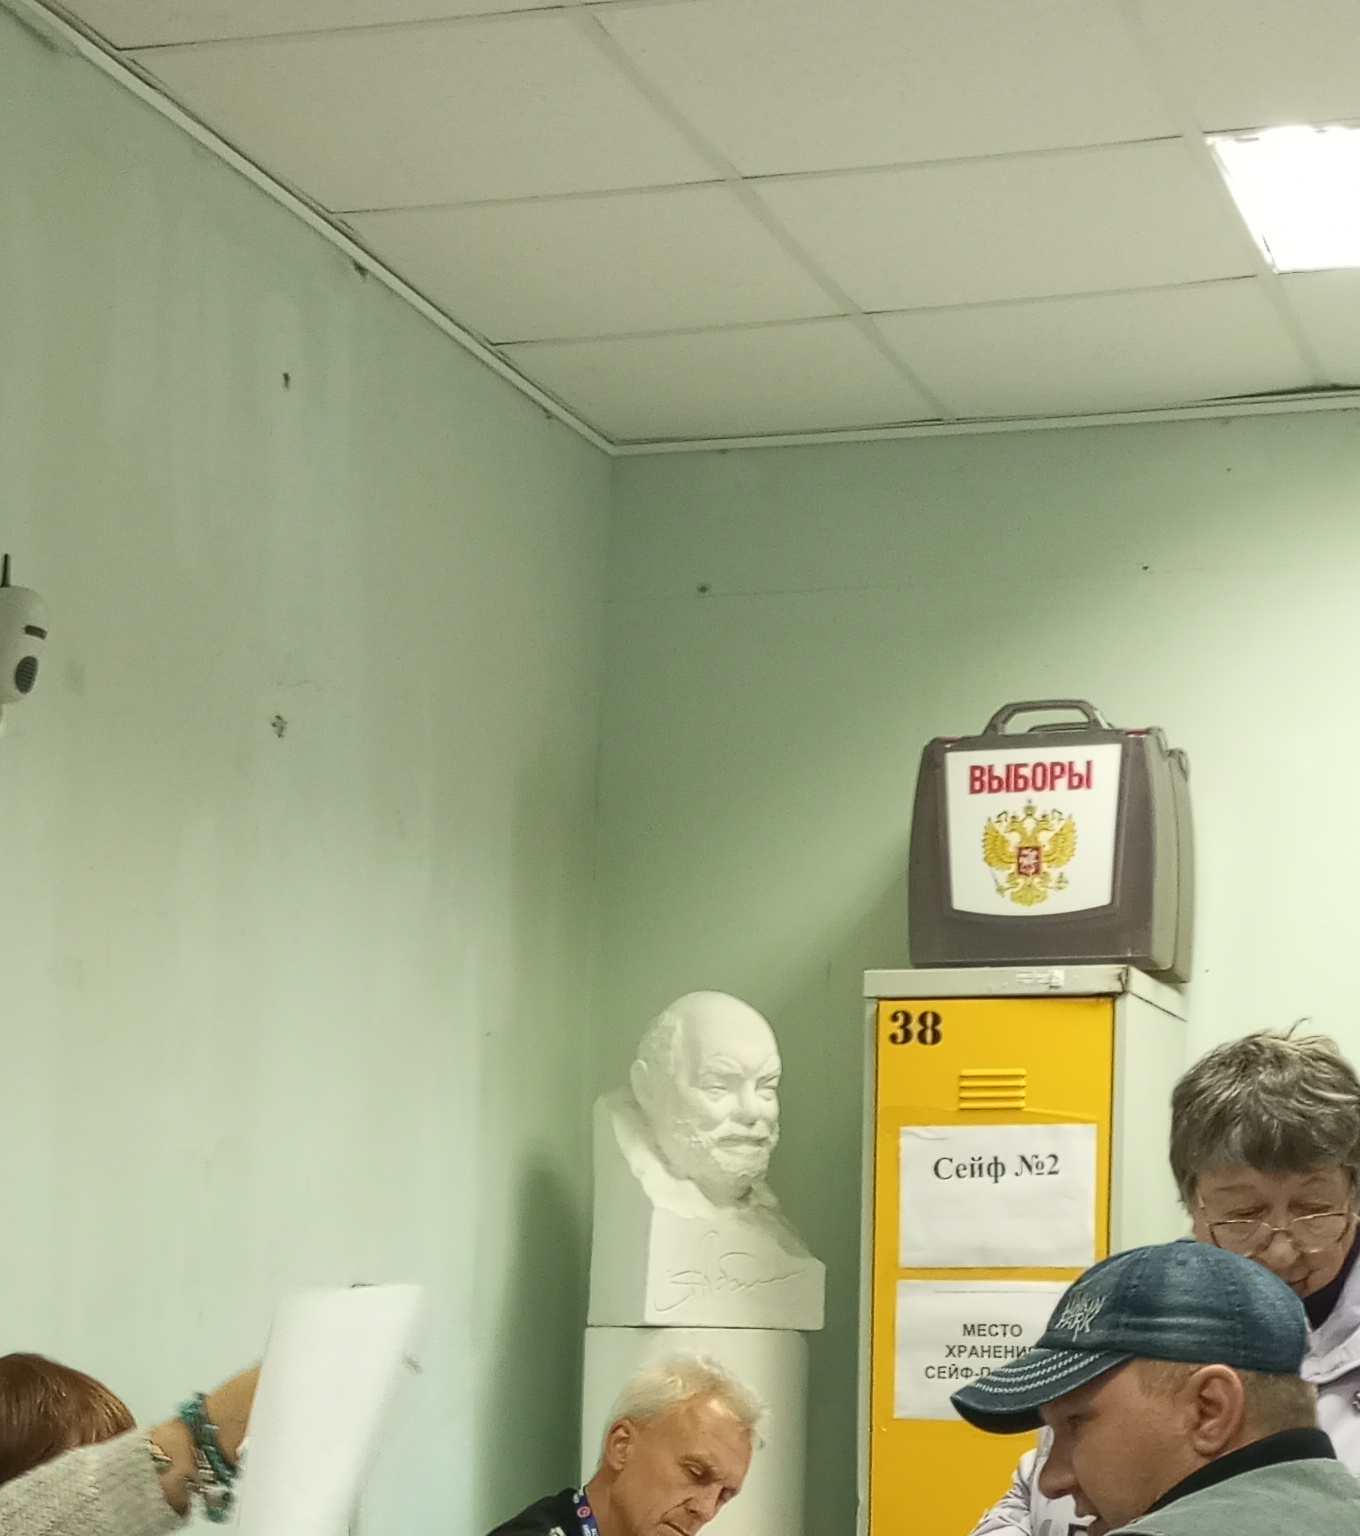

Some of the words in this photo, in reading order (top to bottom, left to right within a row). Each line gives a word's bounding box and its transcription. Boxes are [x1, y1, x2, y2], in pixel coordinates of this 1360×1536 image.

[969, 760, 1093, 795] ВЫБОРЫ
[889, 1010, 942, 1046] 38
[933, 1155, 1006, 1184] Сейф
[1015, 1153, 1060, 1177] №2
[962, 1323, 1023, 1338] МЕСТО
[924, 1363, 991, 1379] СЕЙФ-П
